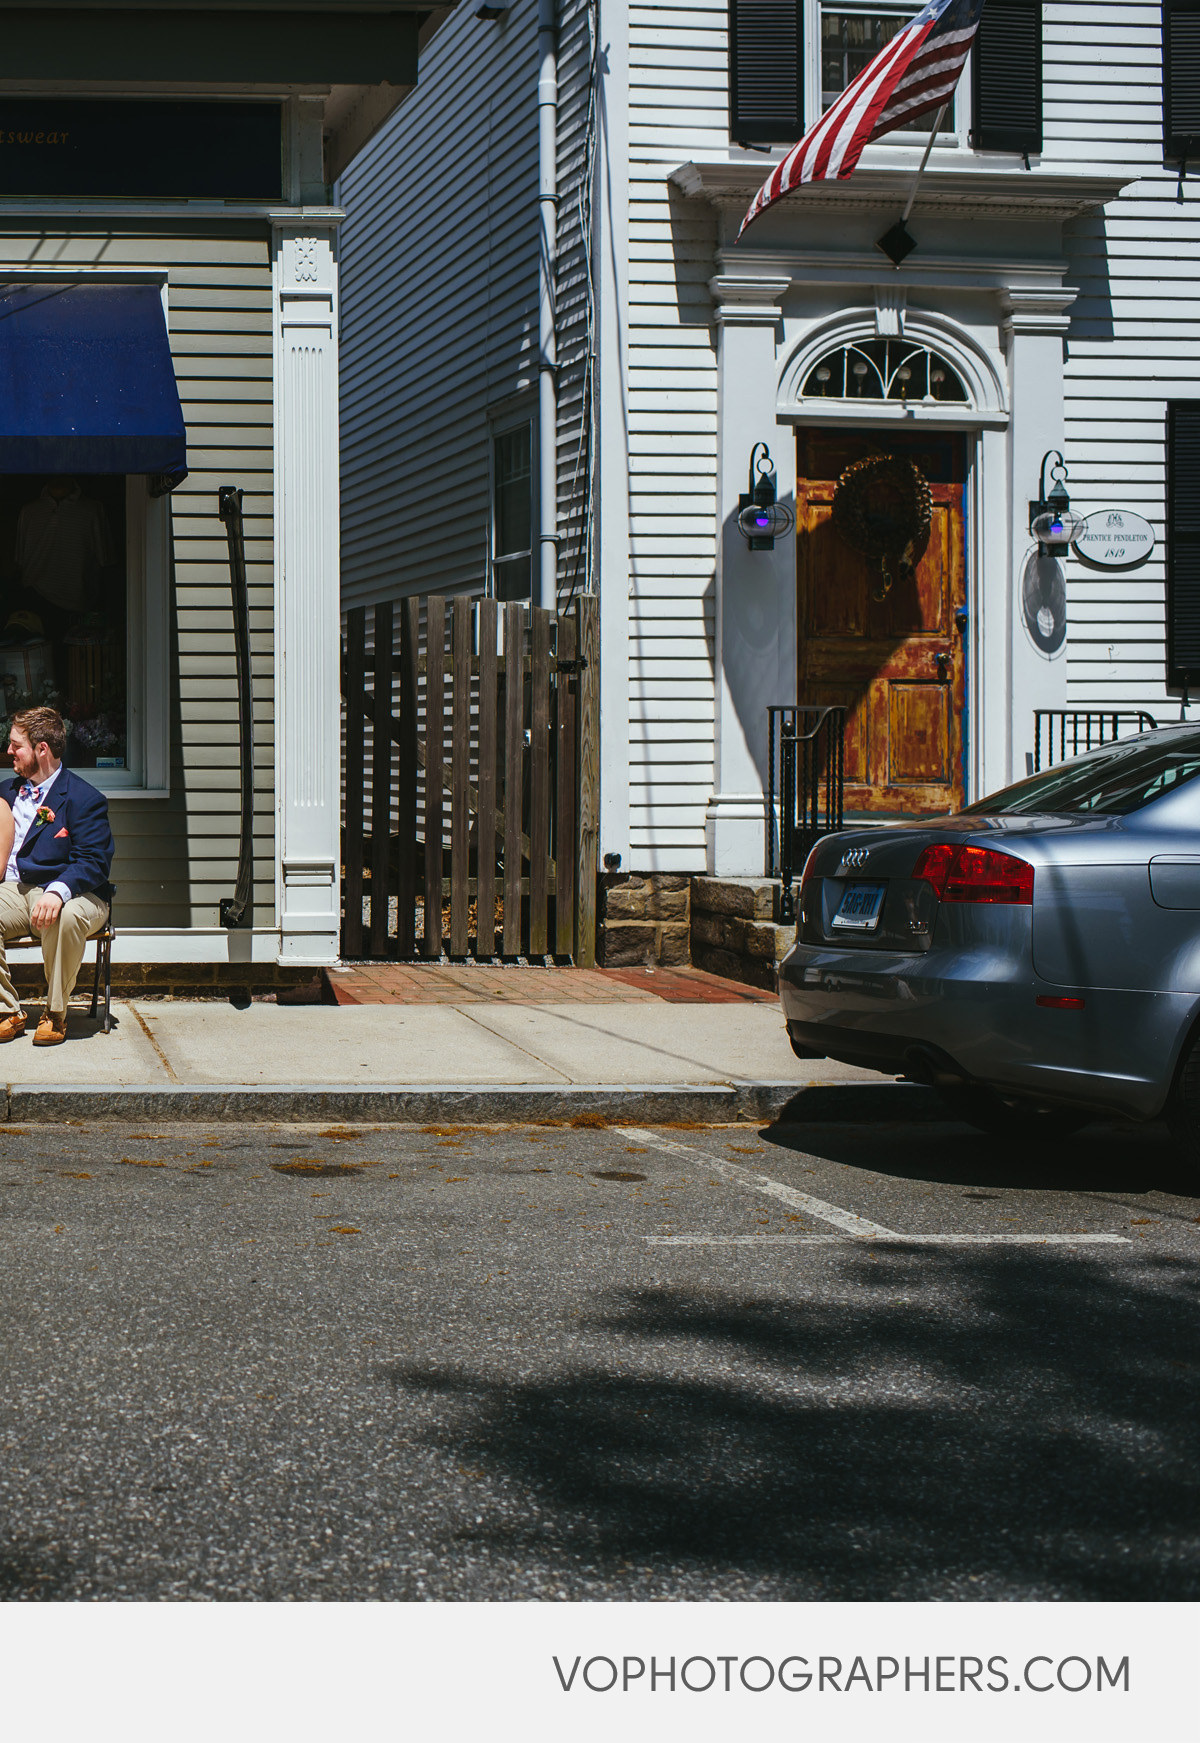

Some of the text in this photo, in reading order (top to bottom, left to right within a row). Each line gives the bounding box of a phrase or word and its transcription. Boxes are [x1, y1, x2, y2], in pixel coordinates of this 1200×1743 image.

[1082, 533, 1148, 542] PRENTICE PENDLETON
[1104, 547, 1126, 558] 1819
